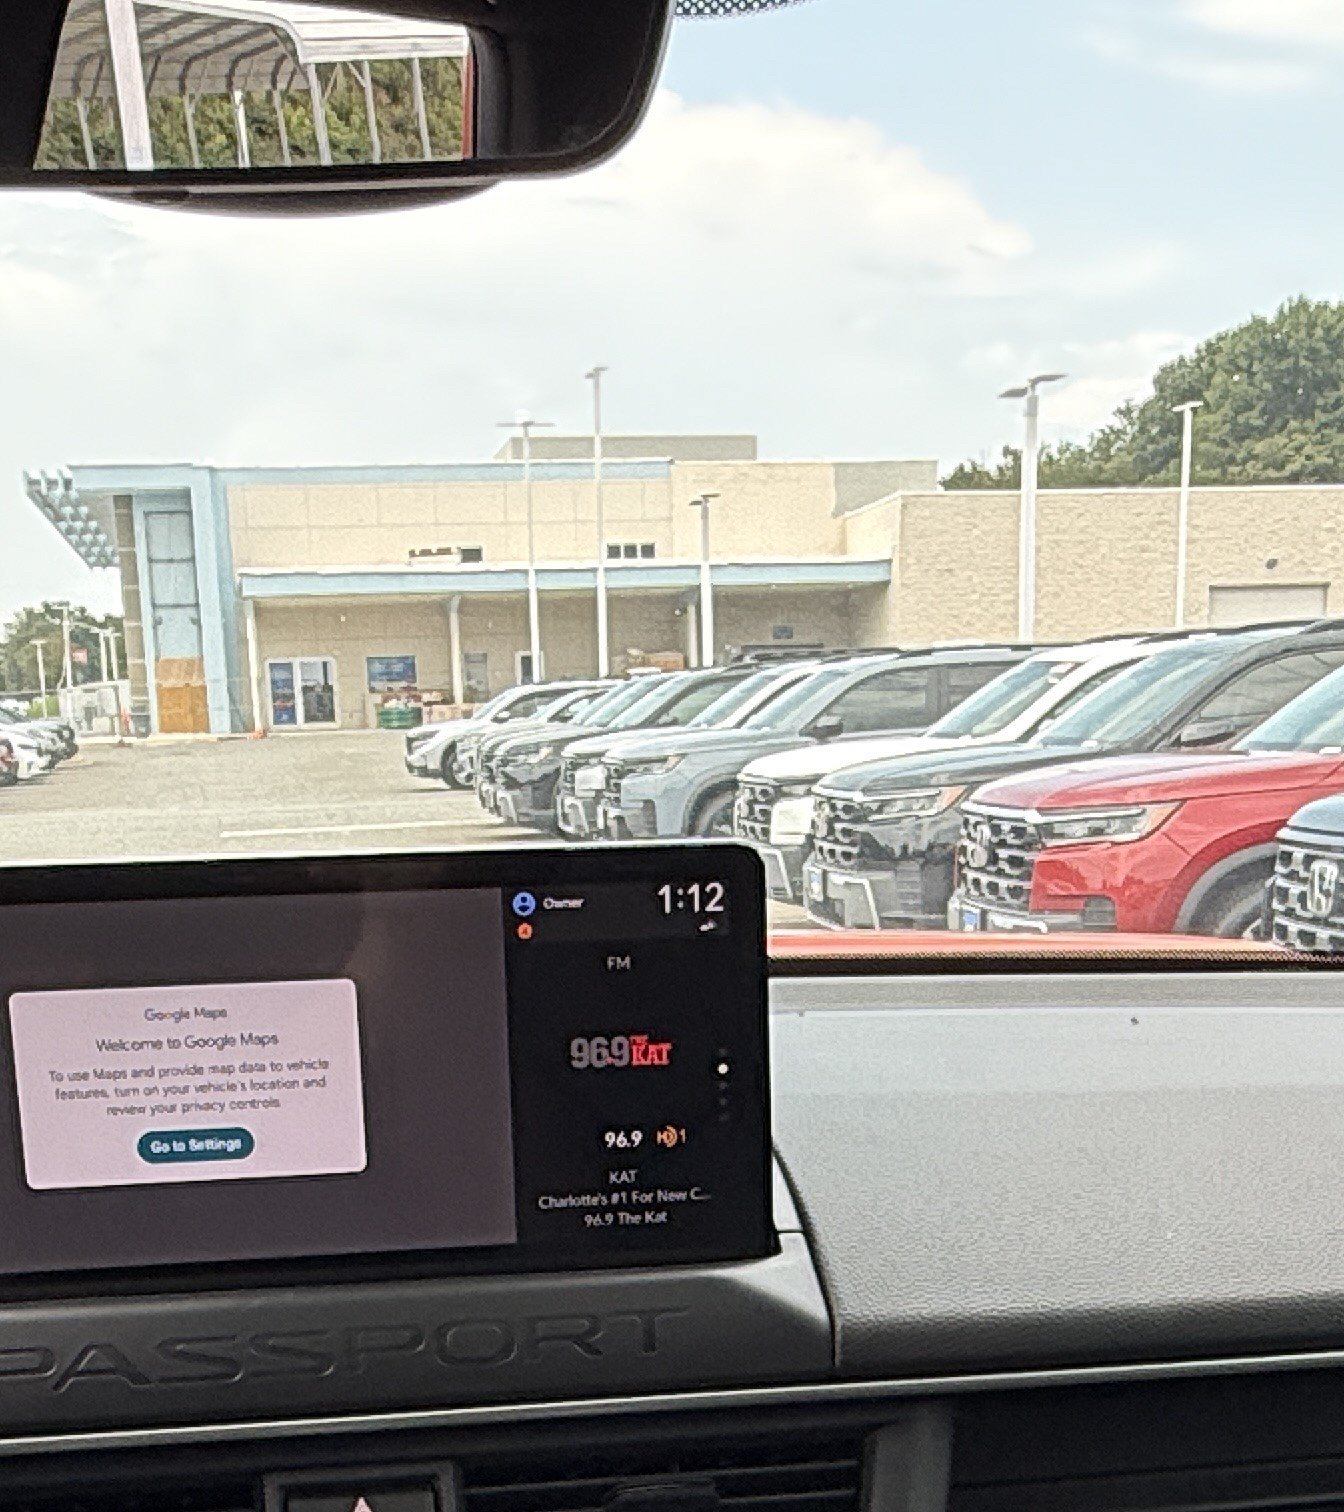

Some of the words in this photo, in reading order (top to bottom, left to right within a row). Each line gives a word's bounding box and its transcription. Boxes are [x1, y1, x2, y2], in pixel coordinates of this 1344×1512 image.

[658, 882, 724, 914] 1:12
[606, 955, 631, 970] FM
[144, 1006, 190, 1023] Google
[194, 1006, 227, 1020] Maps
[95, 1038, 163, 1051] Welcome
[167, 1037, 181, 1049] to
[185, 1034, 236, 1051] Google
[240, 1032, 279, 1048] Maps
[49, 1071, 64, 1082] To
[67, 1072, 89, 1081] use
[93, 1067, 127, 1081] Maps
[131, 1065, 154, 1078] and
[158, 1063, 204, 1079] provide
[208, 1064, 235, 1076] map
[239, 1061, 266, 1073] data
[269, 1061, 283, 1072] to
[287, 1058, 329, 1071] vehicle
[114, 1085, 140, 1097] turn
[143, 1084, 159, 1096] on
[162, 1084, 190, 1097] your
[194, 1080, 248, 1094] vehicle's
[250, 1077, 299, 1091] location
[303, 1075, 326, 1088] and
[106, 1104, 146, 1116] review
[150, 1103, 177, 1116] your
[181, 1100, 226, 1113] privacy
[150, 1140, 170, 1153] Go
[173, 1139, 186, 1151] to
[189, 1137, 242, 1153] Settings
[605, 1131, 643, 1147] 96.9
[609, 1170, 638, 1183] KAT
[539, 1193, 607, 1209] Charlotte's
[611, 1191, 626, 1204] #1
[632, 1189, 654, 1203] For
[658, 1187, 688, 1201] New
[585, 1213, 614, 1227] 96.9
[618, 1212, 642, 1225] The
[645, 1210, 668, 1223] Kat
